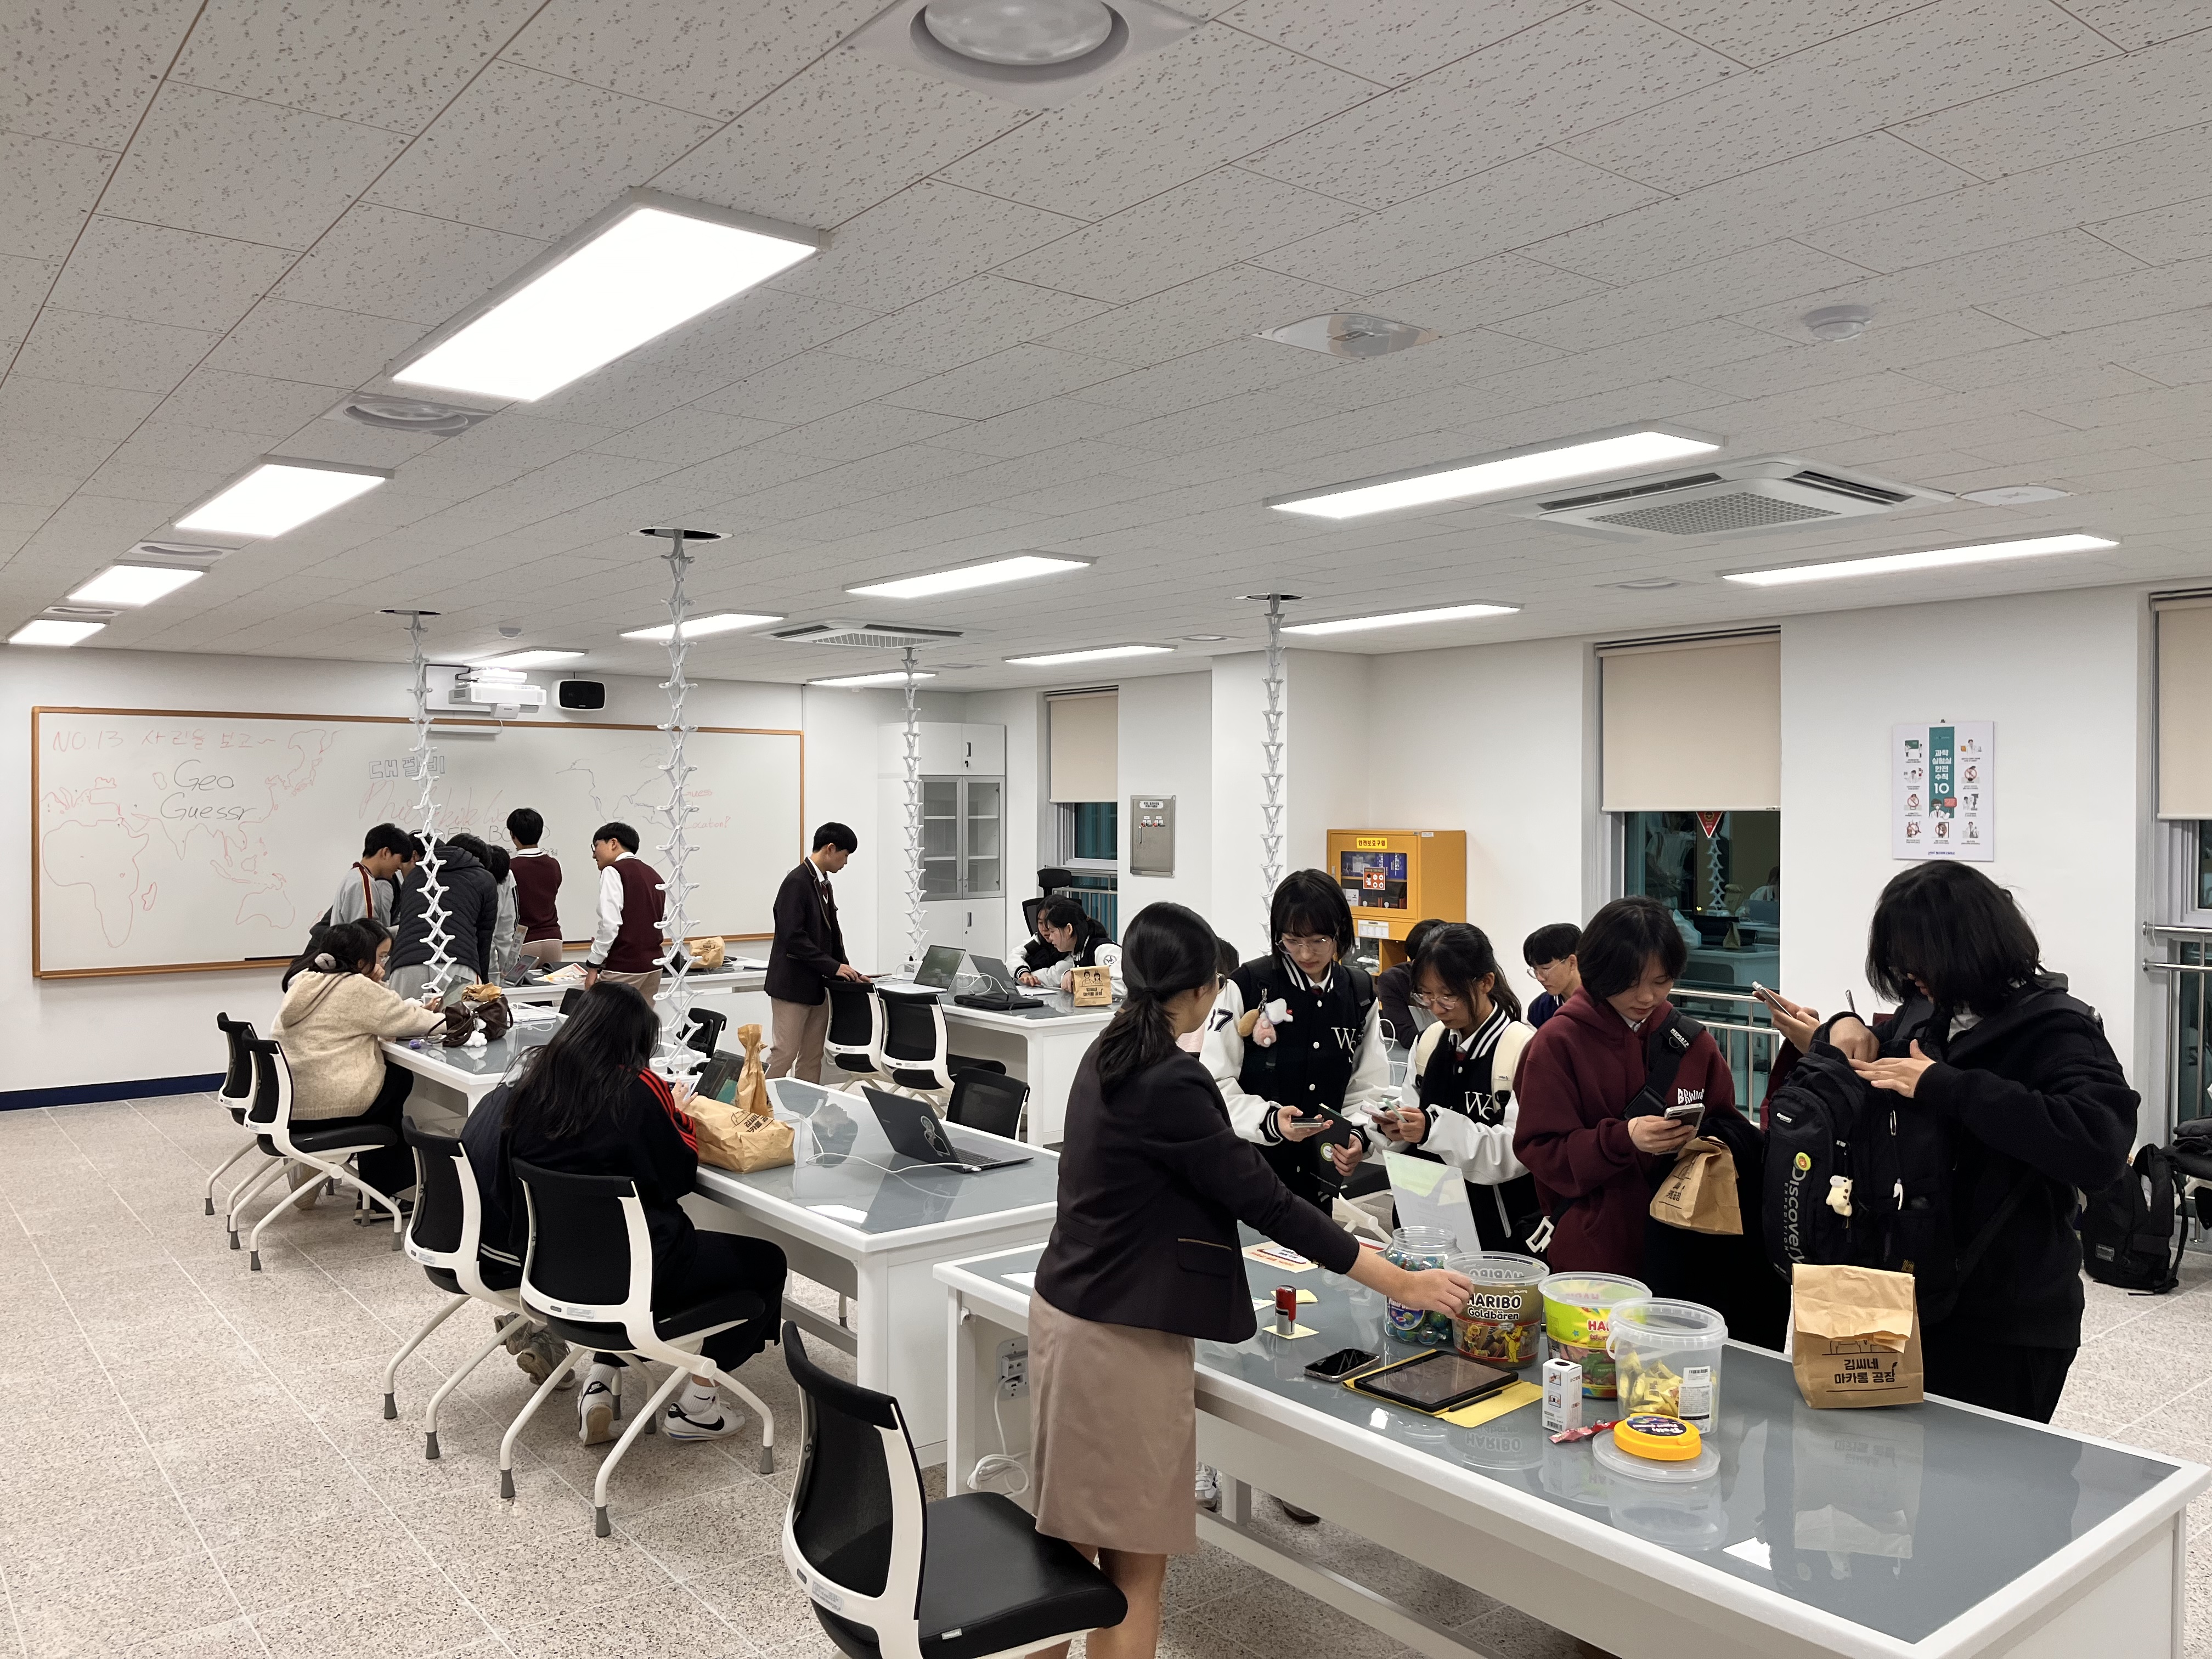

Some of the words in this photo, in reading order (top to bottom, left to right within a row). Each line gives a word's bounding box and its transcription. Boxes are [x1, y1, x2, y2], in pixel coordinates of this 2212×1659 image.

[173, 759, 234, 792] Geo
[1934, 782, 1950, 794] 10
[160, 792, 257, 821] Guessr
[1788, 1166, 1807, 1264] Discovery
[1467, 1294, 1522, 1310] HARIBO
[1468, 1307, 1519, 1321] Goldbären
[1844, 1358, 1879, 1370] 김씨네
[1834, 1372, 1869, 1384] 마카롱
[1872, 1367, 1896, 1383] 공장
